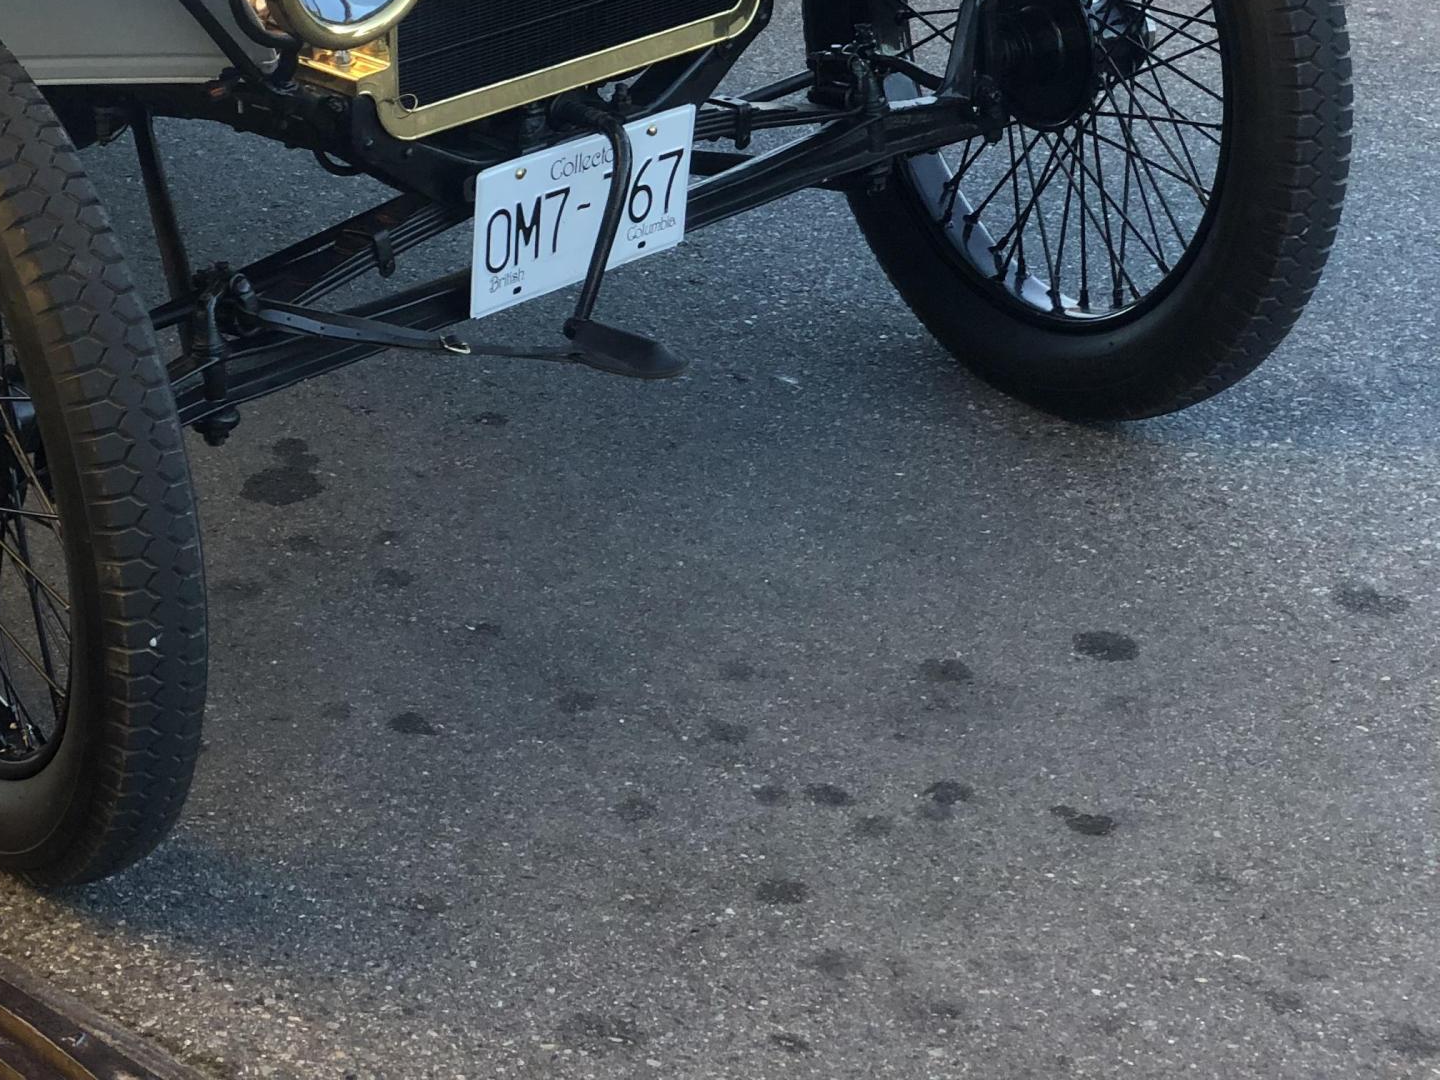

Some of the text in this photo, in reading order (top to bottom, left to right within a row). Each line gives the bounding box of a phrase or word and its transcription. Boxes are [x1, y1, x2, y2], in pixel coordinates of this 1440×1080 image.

[550, 148, 614, 181] Collecto
[488, 215, 676, 294] British Columbia
